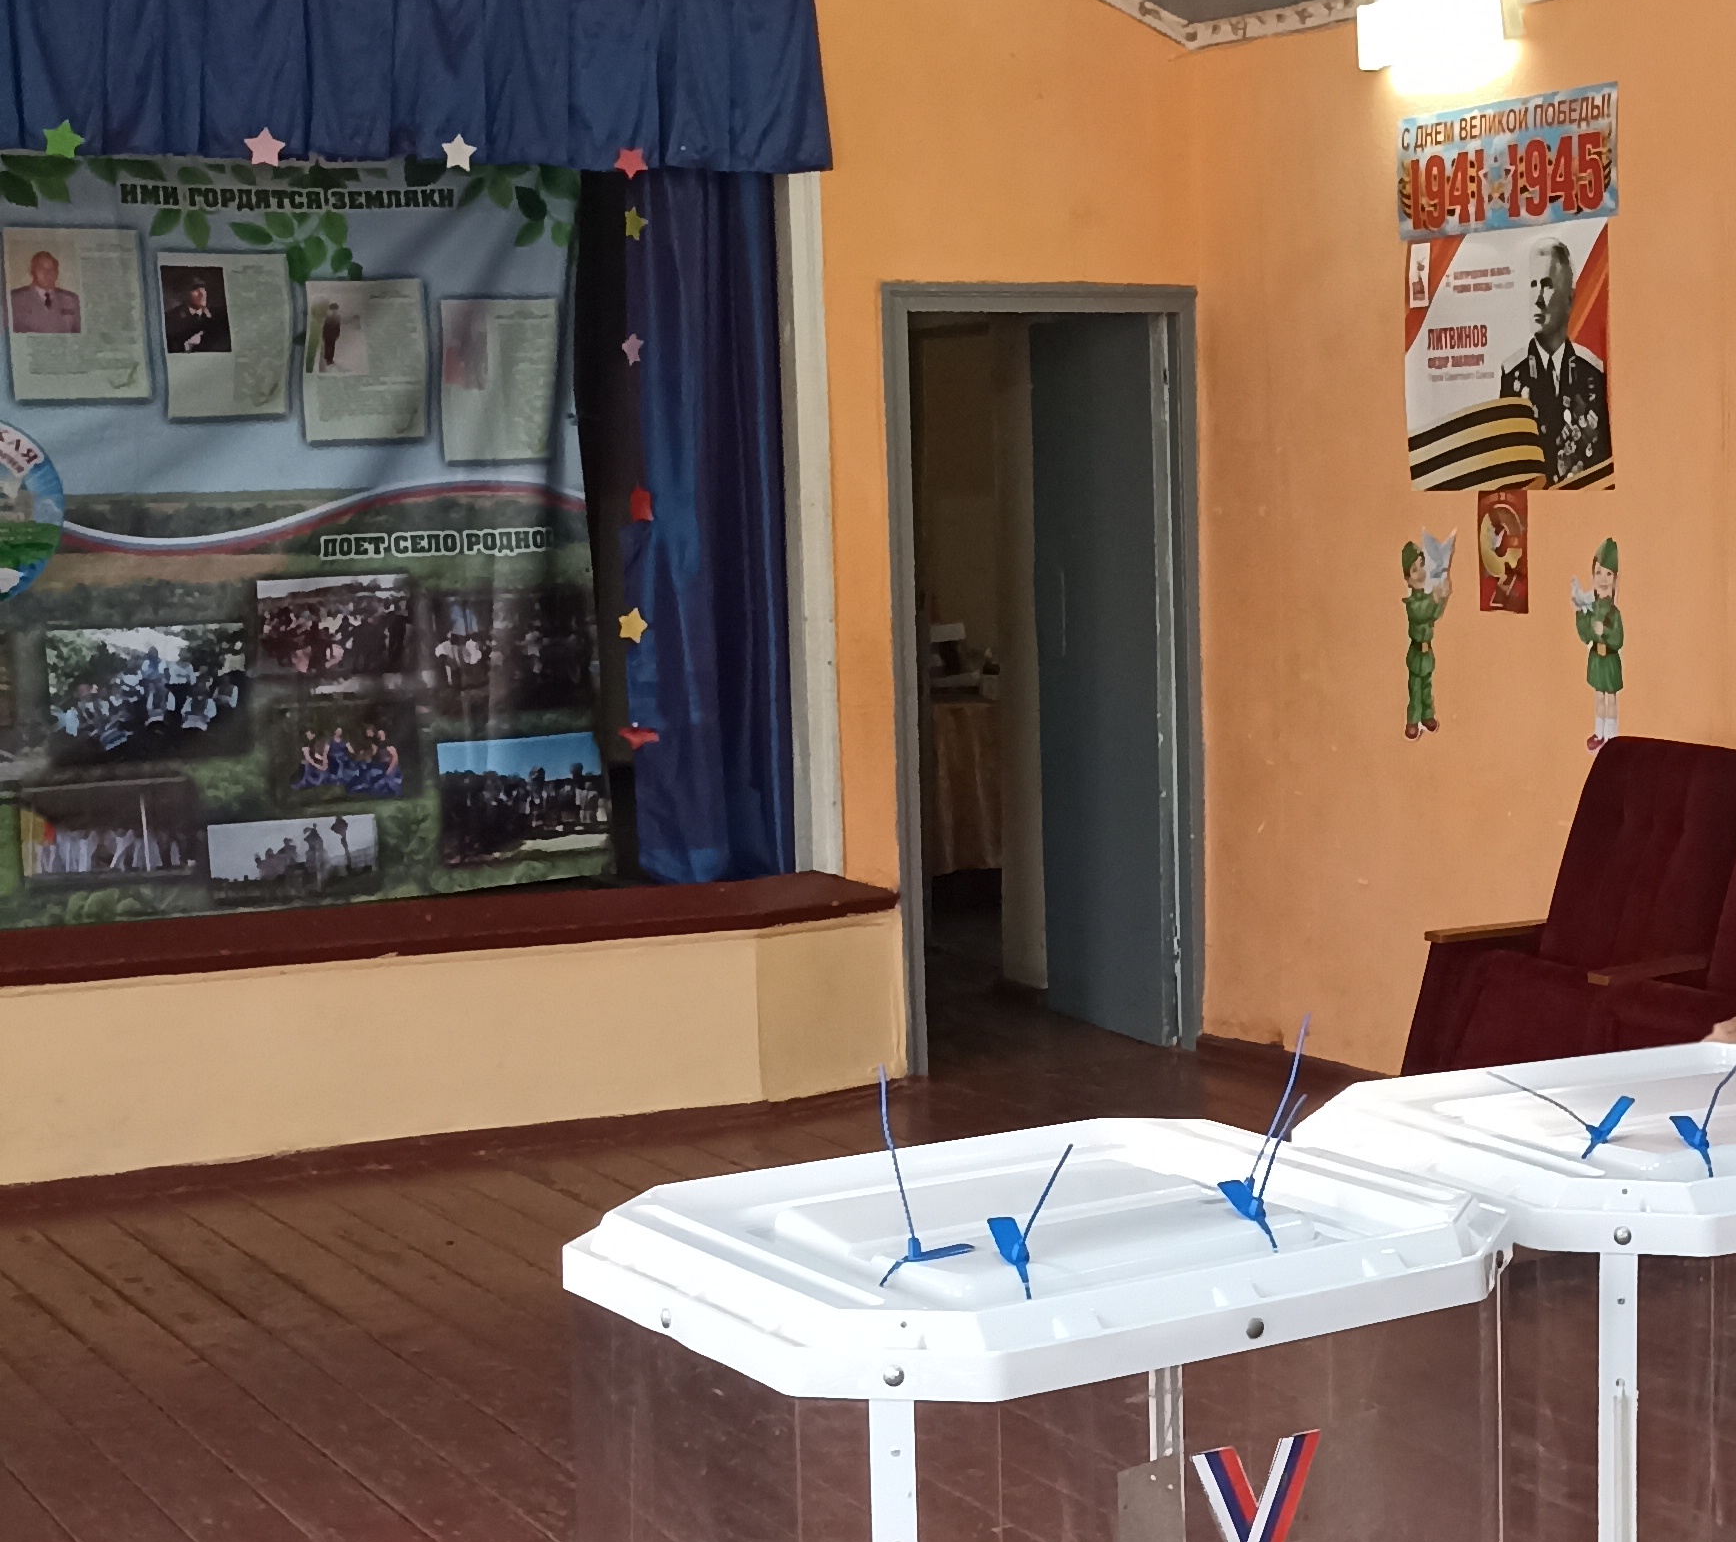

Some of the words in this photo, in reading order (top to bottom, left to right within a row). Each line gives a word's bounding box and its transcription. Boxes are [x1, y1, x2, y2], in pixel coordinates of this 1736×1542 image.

[1402, 128, 1411, 150] С
[1410, 149, 1486, 230] 1941
[1507, 130, 1604, 219] 1945
[188, 187, 323, 211] ГОРДЯТСЯ
[330, 188, 455, 210] ЗЕМЛЯКИ
[1427, 325, 1488, 350] ЛИТВИНОВ
[323, 536, 386, 558] ПОЕТ
[393, 533, 458, 554] СЕЛО
